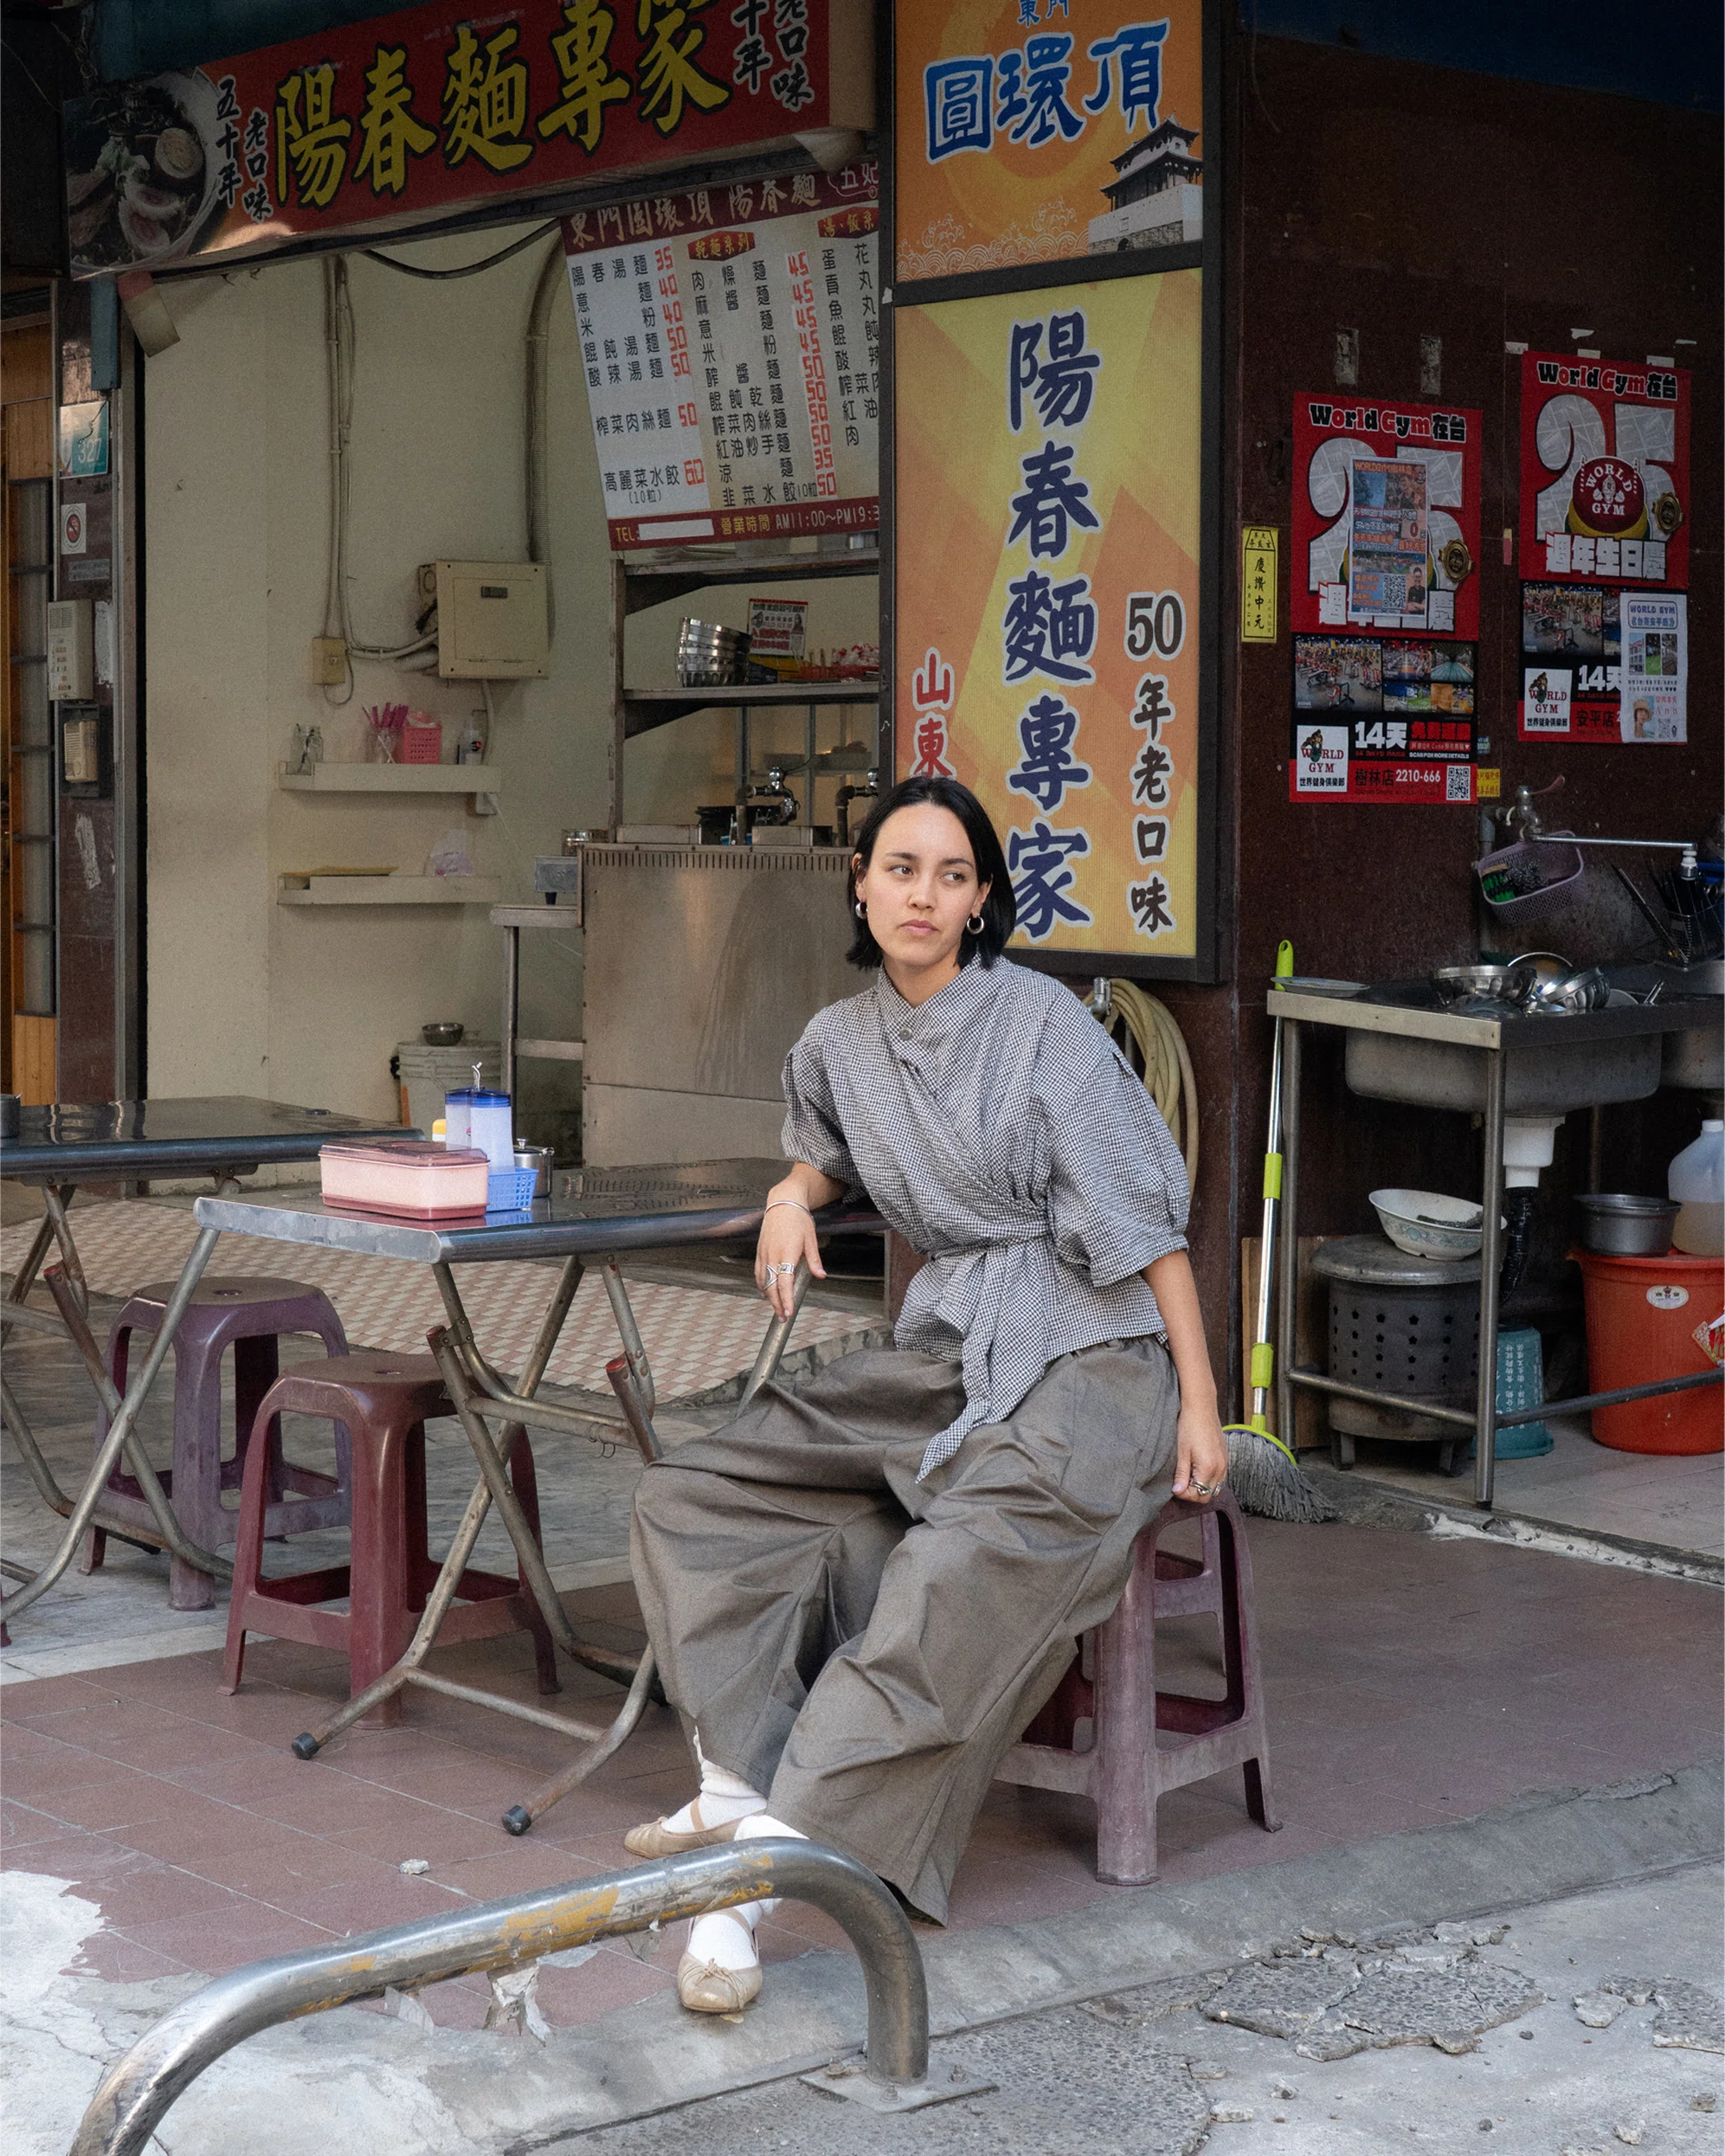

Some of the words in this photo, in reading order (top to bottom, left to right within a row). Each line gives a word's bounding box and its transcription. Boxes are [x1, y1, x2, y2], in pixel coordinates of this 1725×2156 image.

[923, 17, 1170, 165] 圓環頂
[274, 0, 732, 210] 陽春麵專家
[215, 75, 242, 208] 五十年
[242, 107, 273, 222] 老口味
[694, 234, 750, 259] 乾麵系列
[822, 242, 869, 270] 蛋花
[571, 254, 648, 286] 陽春湯麵
[655, 245, 674, 271] 35
[692, 260, 767, 291] 肉燥麵
[787, 251, 809, 277] 45
[659, 274, 678, 298] 40
[825, 270, 873, 296] 貢丸
[695, 285, 770, 316] 麻醬麵
[792, 279, 814, 304] 45
[829, 295, 876, 322] 魚丸
[662, 300, 682, 324] 40
[795, 305, 818, 328] 45
[583, 332, 660, 363] 餛飩湯麵
[667, 325, 687, 352] 50
[799, 329, 821, 353] 45
[587, 359, 663, 387] 酸辣湯麵
[670, 351, 691, 376] 50
[802, 355, 825, 379] 50
[1537, 361, 1600, 389] World
[1601, 370, 1646, 395] Gym
[709, 383, 784, 411] 餛飩乾麵
[806, 380, 827, 402] 50
[596, 408, 671, 437] 榨菜肉絲麵
[678, 402, 698, 427] 50
[712, 408, 787, 436] 榨菜肉絲麵
[808, 403, 829, 423] 50
[843, 399, 878, 422] 紅油
[1308, 403, 1378, 431] World
[1380, 411, 1430, 438] Gym
[716, 432, 791, 461] 紅油炒手麵
[811, 423, 831, 447] 50
[845, 425, 859, 446] 肉
[814, 447, 833, 470] 35
[604, 464, 681, 492] 高麗菜水餃
[684, 458, 705, 486] 60
[817, 472, 837, 496] 50
[1585, 463, 1633, 492] WORLD
[629, 489, 662, 505] (10粒)
[1592, 503, 1625, 516] GYM
[720, 514, 770, 535] 營業時間
[1002, 304, 1101, 943] 陽春麵專家
[1630, 605, 1656, 614] WORLD
[1659, 605, 1676, 615] GYM
[909, 647, 957, 779] 山東
[1534, 704, 1559, 714] GYM
[1576, 710, 1615, 728] 安平店
[1354, 721, 1408, 749] 14天
[1308, 762, 1335, 773] GYM
[1355, 768, 1395, 787] 樹林店
[1396, 770, 1441, 783] 2210-666
[1299, 777, 1346, 787] 世界健身俱樂部
